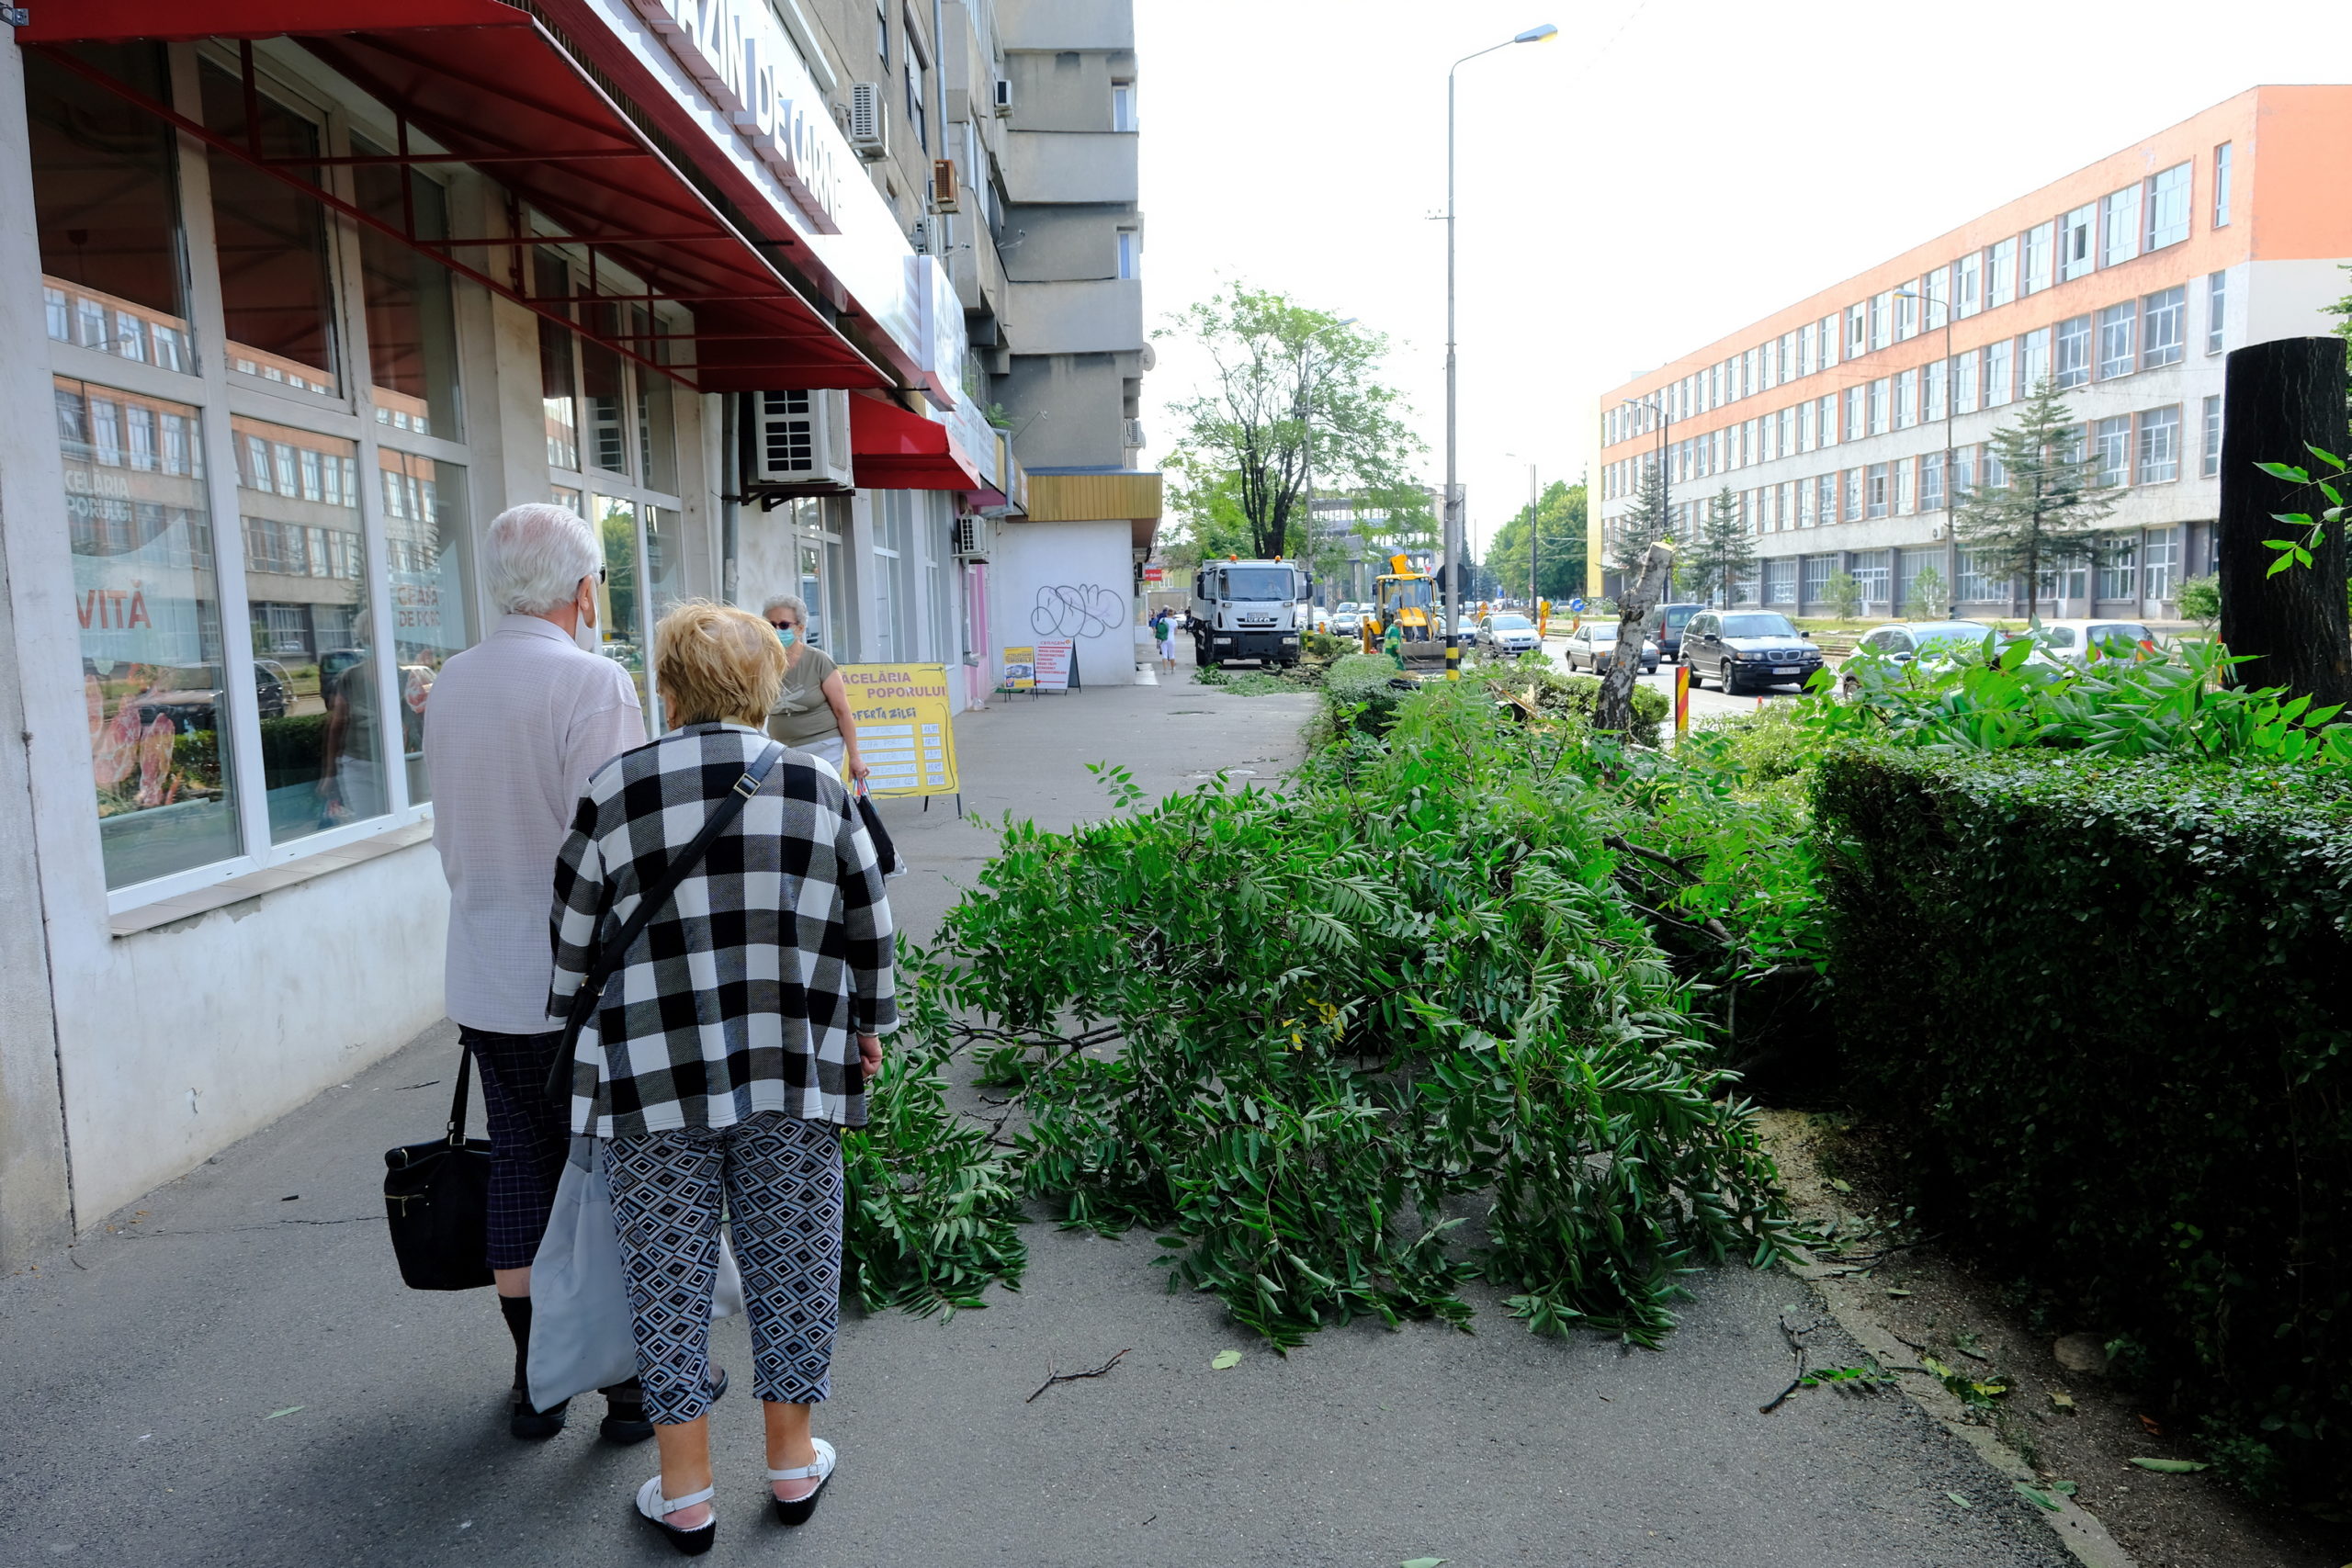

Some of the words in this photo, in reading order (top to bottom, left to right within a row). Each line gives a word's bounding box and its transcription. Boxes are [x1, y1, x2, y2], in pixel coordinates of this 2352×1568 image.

[745, 39, 788, 163] DE
[64, 468, 130, 500] CELĂRIA
[76, 579, 152, 629] VITĂ
[398, 610, 415, 627] DE
[842, 671, 911, 684] ĂCELĂRIA
[866, 686, 946, 698] POPORULUI
